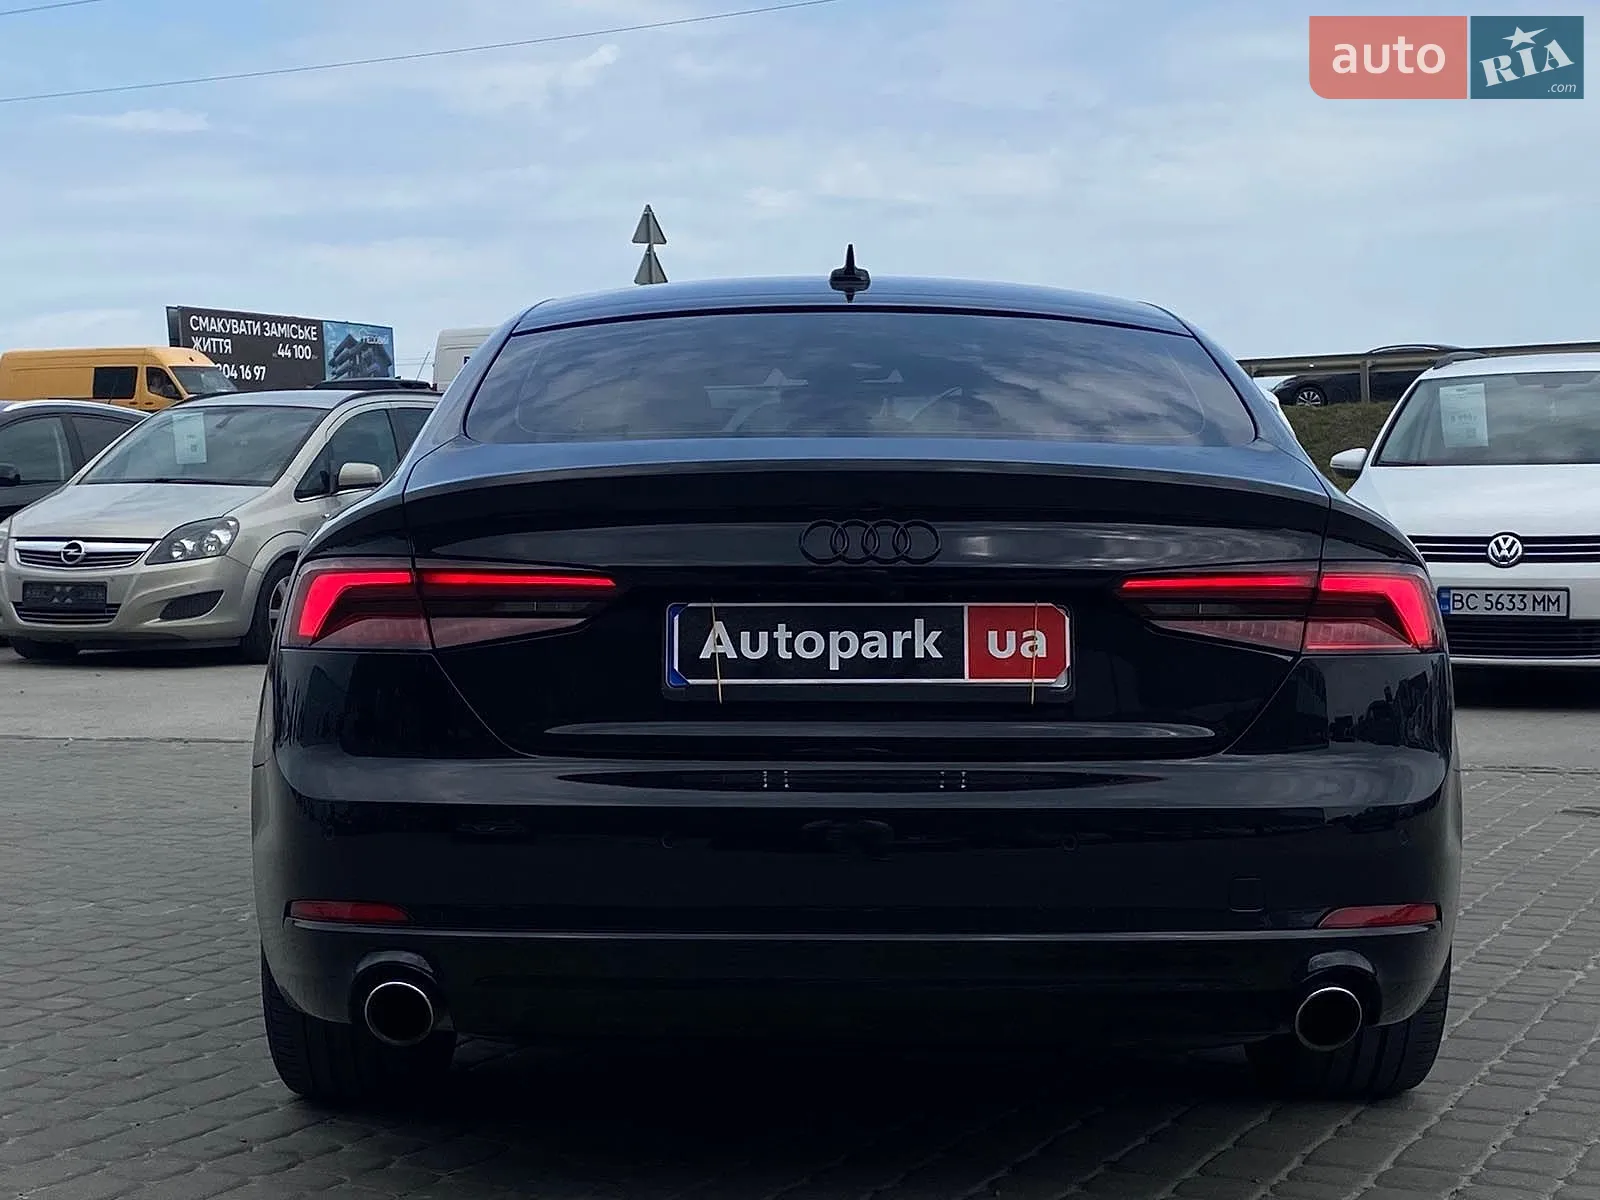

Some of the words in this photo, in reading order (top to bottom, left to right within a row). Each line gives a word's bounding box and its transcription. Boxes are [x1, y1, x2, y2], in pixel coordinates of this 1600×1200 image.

[190, 315, 261, 337] СМАКУВАТИ
[263, 321, 318, 341] ЗАМІСЬКЕ
[191, 336, 232, 354] ЖИТТЯ
[277, 343, 291, 358] 44
[293, 345, 312, 360] 100
[239, 364, 252, 380] 16
[254, 366, 266, 381] 97
[1452, 593, 1478, 611] BC
[1484, 593, 1527, 611] 5633
[1532, 594, 1560, 612] MM
[699, 618, 943, 671] Autopark
[987, 629, 1048, 659] ua
